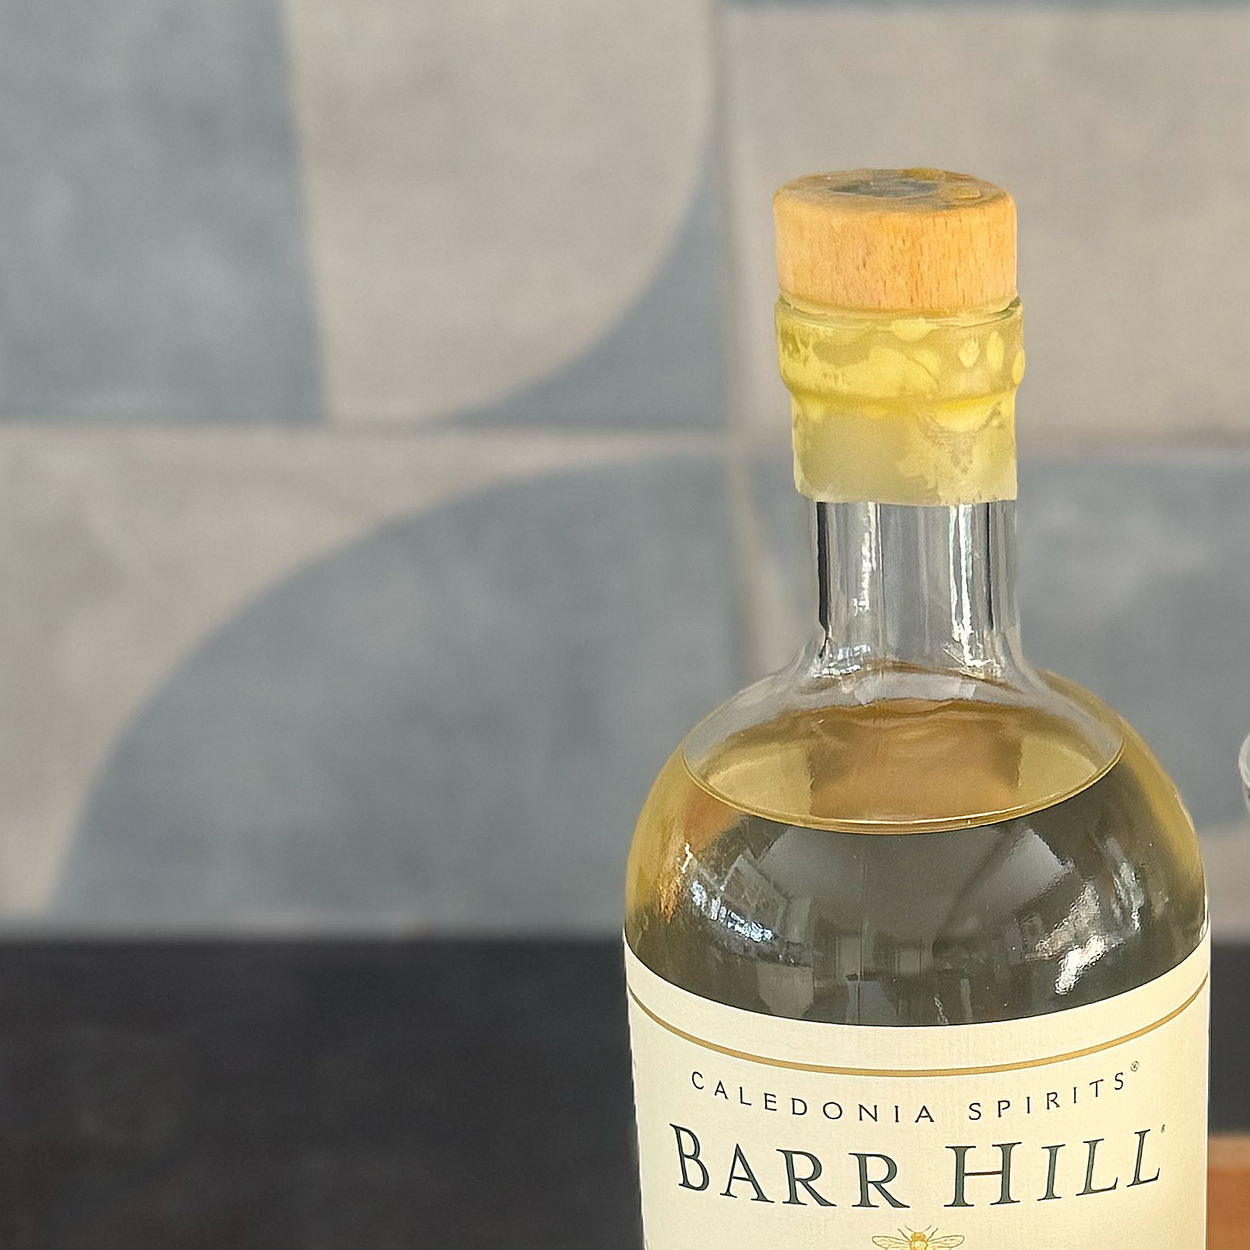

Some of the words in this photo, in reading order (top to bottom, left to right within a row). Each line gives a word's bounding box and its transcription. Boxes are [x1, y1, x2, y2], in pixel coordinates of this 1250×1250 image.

[691, 1071, 935, 1124] CALEDONIA
[669, 1123, 910, 1209] BARR
[944, 1128, 1162, 1208] HILL
